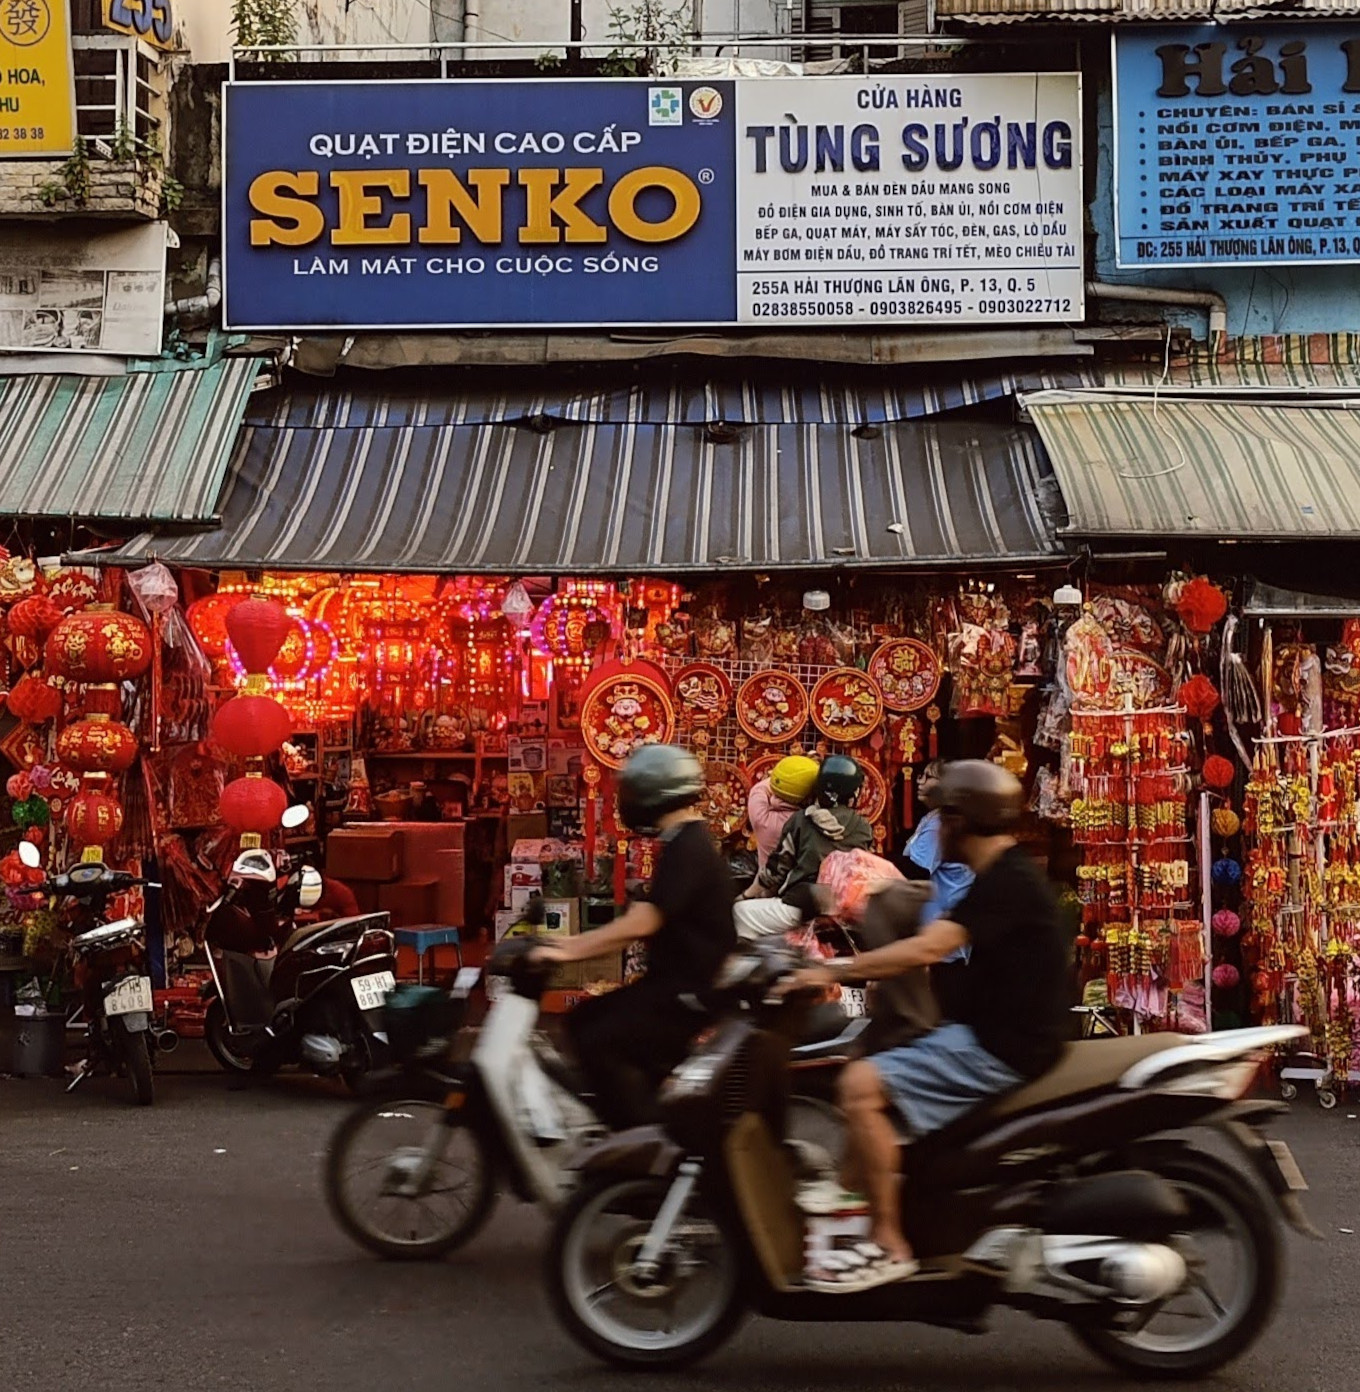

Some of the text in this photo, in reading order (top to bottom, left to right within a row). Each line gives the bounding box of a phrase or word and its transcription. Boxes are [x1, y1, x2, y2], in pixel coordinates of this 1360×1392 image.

[7, 67, 45, 87] HOA,
[1154, 35, 1313, 97] Hải
[857, 83, 962, 109] CỬA HÀNG
[1265, 101, 1314, 116] BÁN
[309, 123, 642, 159] QUẠT ĐIỆN CAO CẤP
[746, 113, 1072, 174] TÙNG SƯƠNG
[811, 179, 1010, 197] MUA & BÁN ĐÈN DẦU MANG SONG
[248, 166, 701, 247] SENKO
[778, 203, 806, 220] ĐIỆN
[811, 205, 831, 217] GIA
[835, 205, 871, 220] DỤNG,
[875, 204, 903, 217] SINH
[906, 201, 926, 218] TỐ,
[930, 202, 954, 216] BÀN
[1003, 201, 1031, 215] CƠM
[1035, 200, 1063, 218] ĐIỆN
[1137, 241, 1158, 259] ĐC:
[1159, 237, 1183, 260] 255
[1185, 236, 1206, 260] HẢI
[1208, 236, 1257, 259] THƯỢNG
[1318, 237, 1331, 254] P.
[1332, 236, 1350, 255] 13,
[293, 250, 659, 277] LÀM MÁT CHO CUỘC SỐNG
[752, 275, 1035, 296] 255A HẢI THƯỢNG LÃN ÔNG, P. 13, Q. 5
[752, 301, 853, 317] 02838550058
[869, 299, 961, 315] 0903826495
[978, 298, 1070, 314] 0903022712
